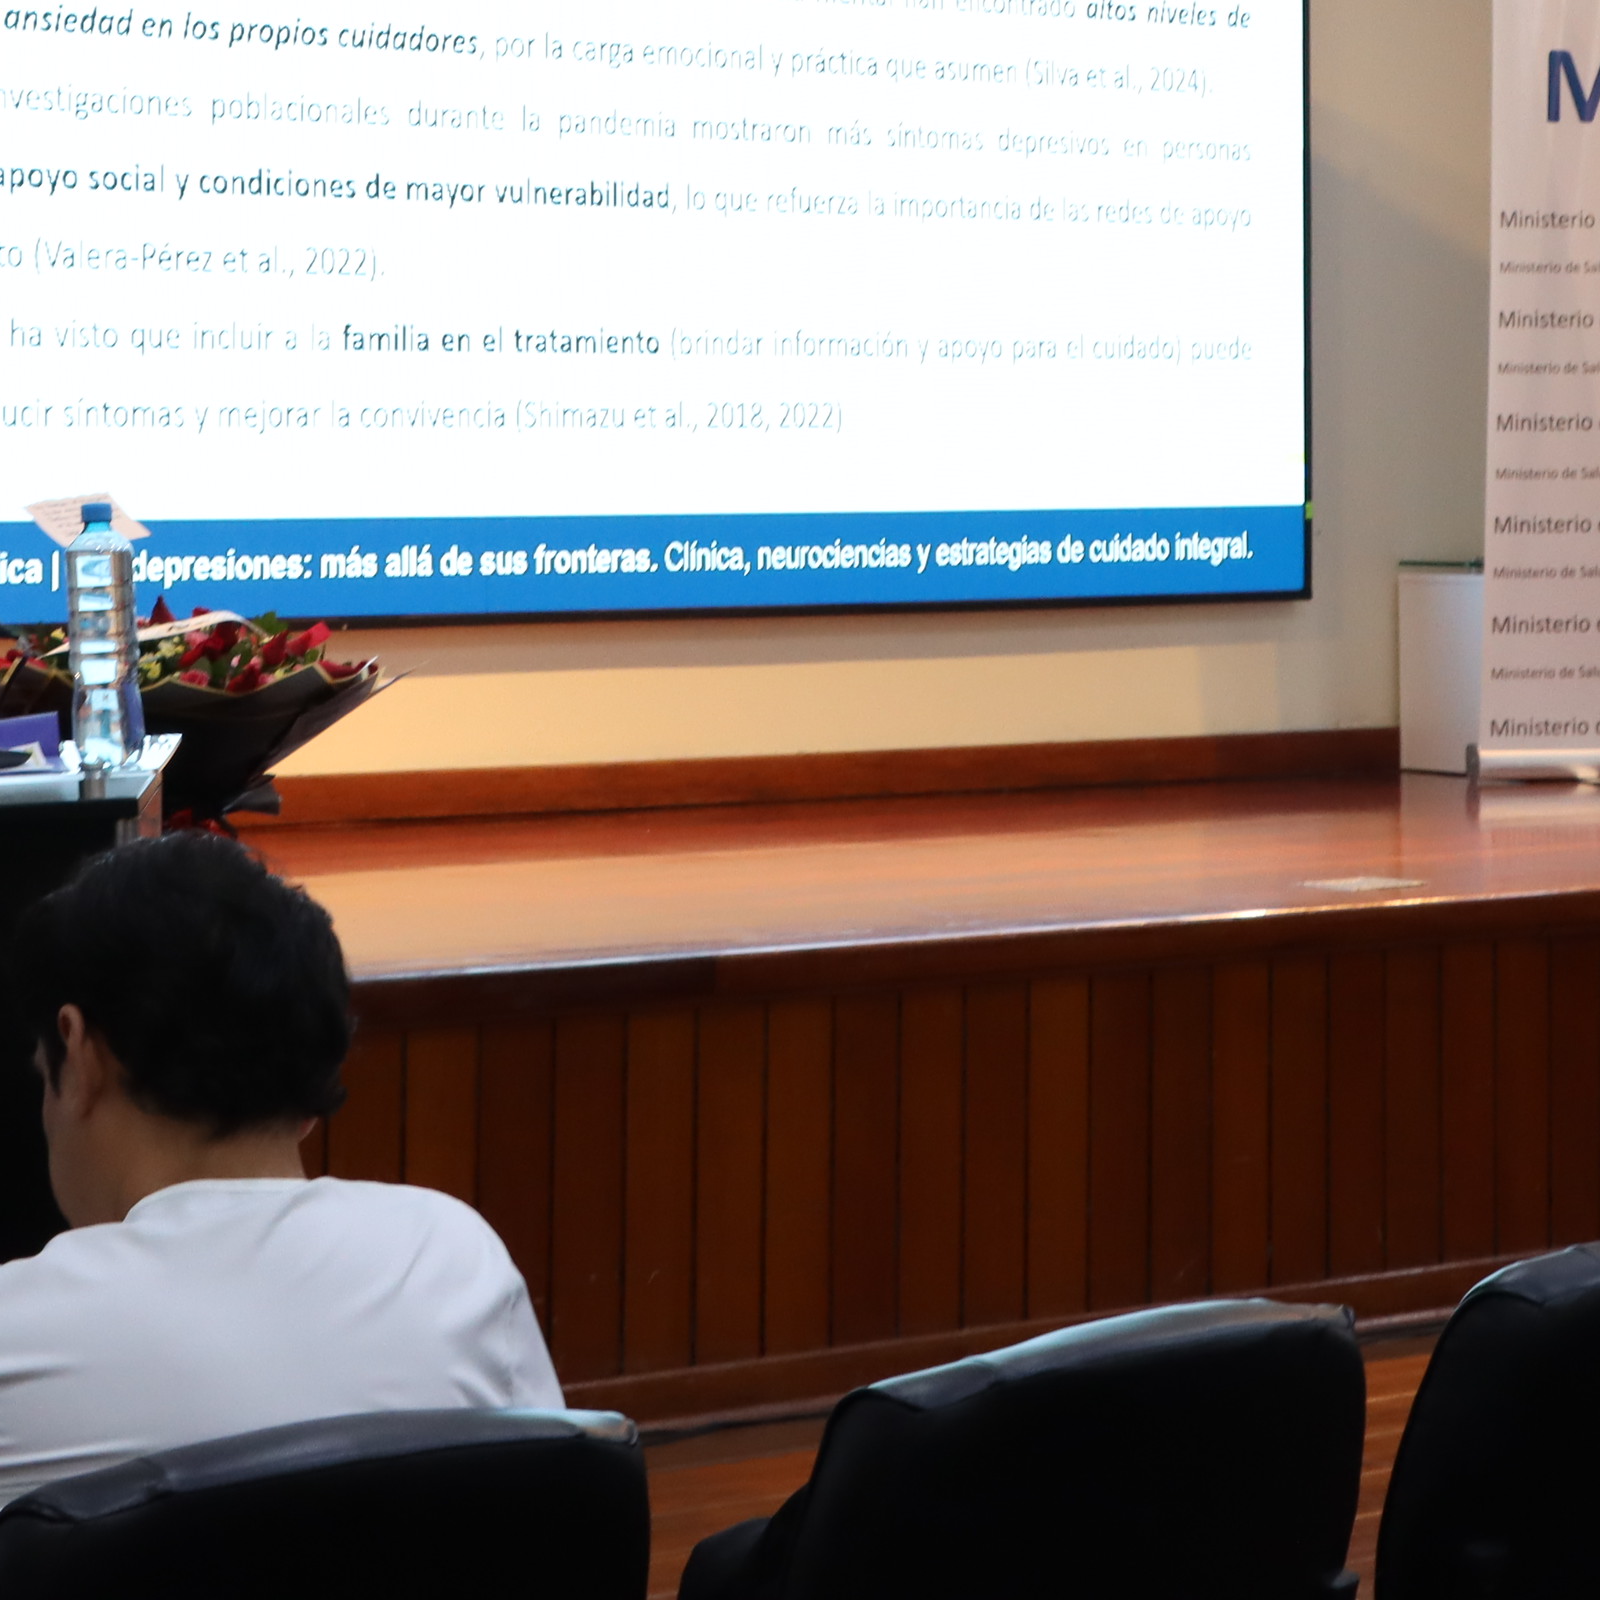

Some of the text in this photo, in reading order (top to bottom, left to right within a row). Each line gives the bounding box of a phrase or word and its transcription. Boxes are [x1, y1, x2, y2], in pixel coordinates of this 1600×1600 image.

[1226, 2, 1253, 30] de
[2, 2, 135, 38] ansiedad
[140, 15, 174, 40] en
[182, 9, 222, 43] los
[227, 16, 331, 53] propios
[337, 20, 486, 62] cuidadores,
[87, 161, 166, 194] social
[174, 172, 191, 202] y
[198, 166, 358, 201] condiciones
[363, 170, 398, 202] de
[405, 180, 488, 211] mayor
[493, 175, 678, 216] vulnerabilidad,
[1500, 210, 1595, 230] Ministerio
[341, 321, 431, 354] familia
[440, 331, 472, 354] en
[481, 324, 504, 354] el
[512, 325, 661, 356] tratamiento
[1496, 412, 1593, 432] Ministerio
[131, 548, 312, 588] depresiones:
[320, 545, 378, 578] más
[384, 544, 433, 577] allá
[440, 545, 473, 576] de
[479, 550, 528, 576] sus
[533, 543, 659, 574] fronteras.
[664, 540, 751, 576] Clínica,
[757, 538, 912, 570] neurociencias
[916, 543, 931, 573] y
[935, 535, 1052, 571] estrategias
[1057, 535, 1085, 563] de
[1089, 532, 1170, 562] cuidado
[1175, 531, 1253, 565] integral.
[1492, 613, 1590, 635] Ministerio
